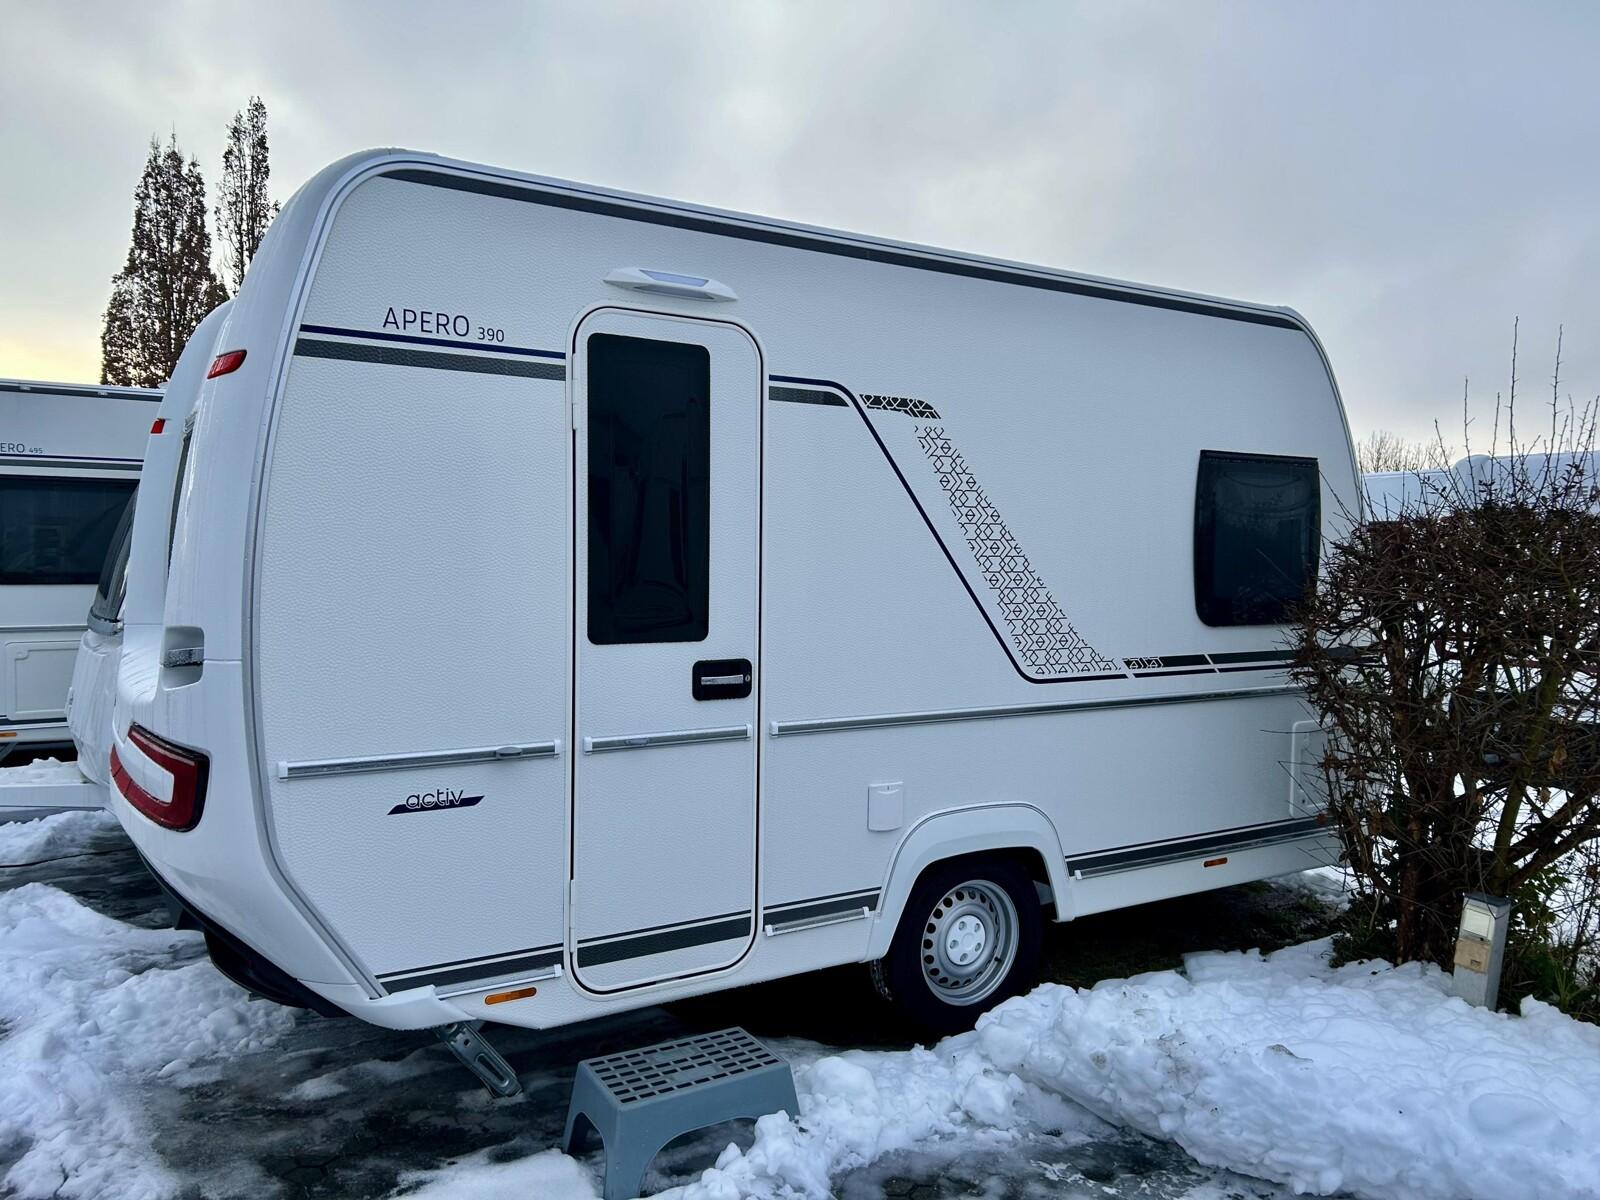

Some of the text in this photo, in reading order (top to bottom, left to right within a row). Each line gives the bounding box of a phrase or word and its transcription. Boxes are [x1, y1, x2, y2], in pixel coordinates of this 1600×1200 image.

[382, 306, 505, 343] APERO 390
[405, 787, 464, 809] activ
